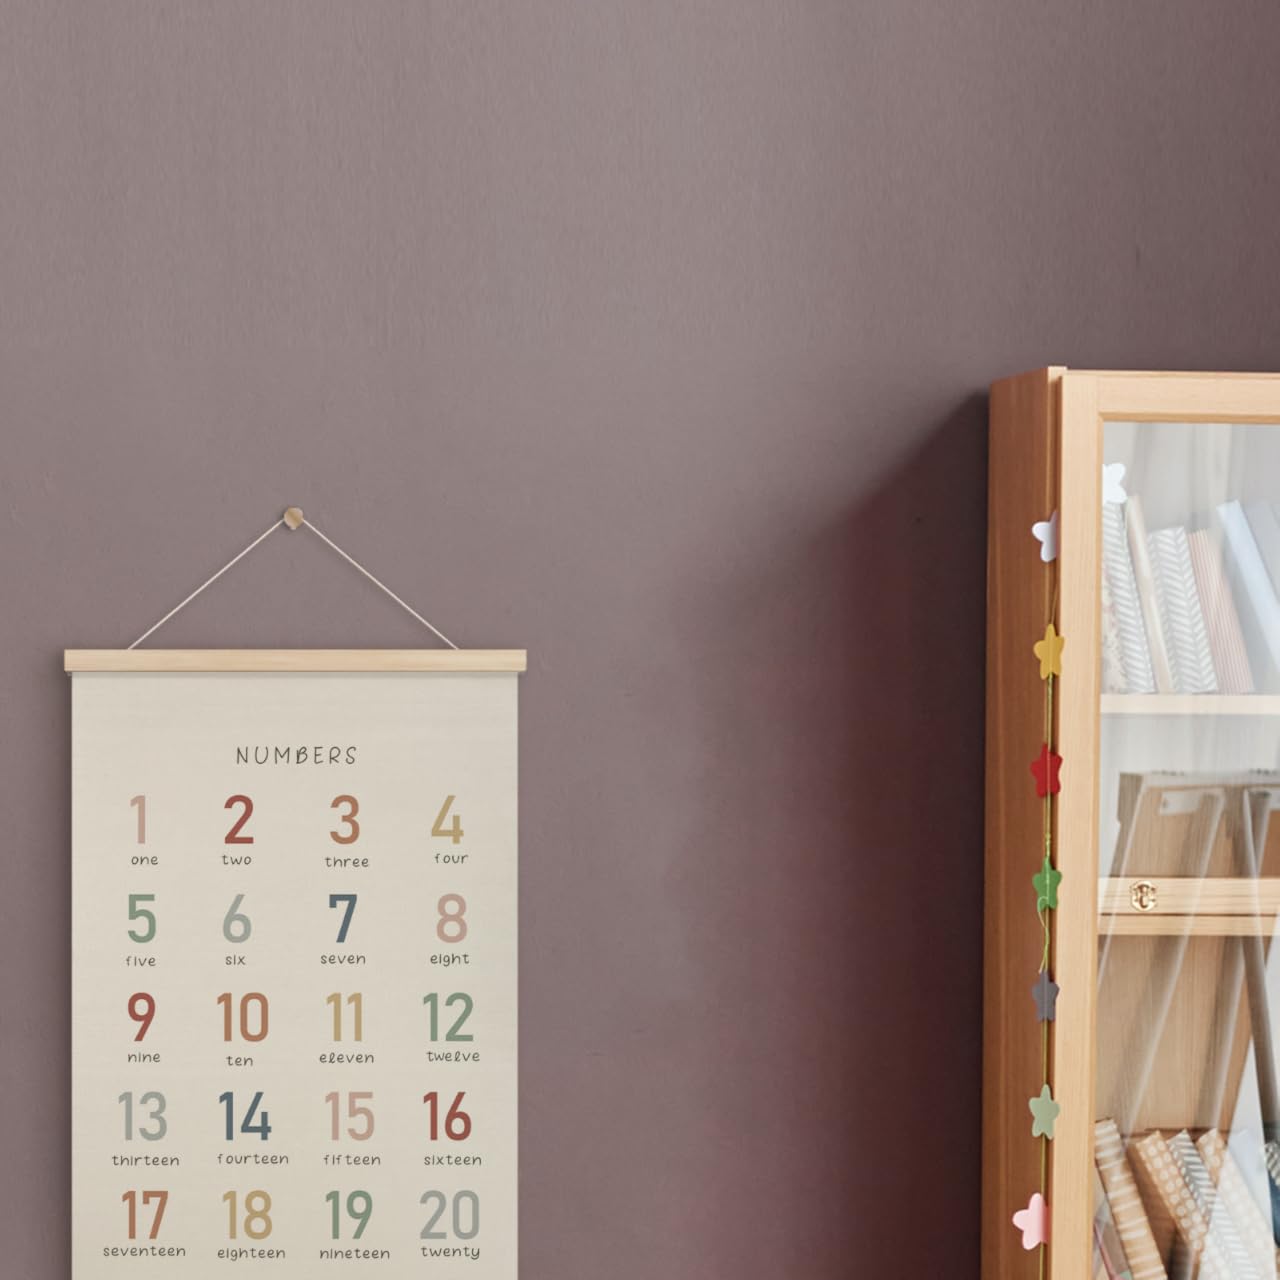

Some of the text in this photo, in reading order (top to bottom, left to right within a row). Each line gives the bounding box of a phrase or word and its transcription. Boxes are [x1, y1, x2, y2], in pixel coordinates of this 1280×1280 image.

[236, 745, 359, 767] NUMBERS
[130, 794, 146, 844] 1
[224, 793, 255, 845] 2
[329, 794, 360, 845] 3
[431, 795, 464, 845] 4
[130, 855, 160, 867] one
[220, 853, 252, 867] two
[324, 855, 370, 871] three
[434, 852, 469, 865] four
[128, 894, 156, 944] 5
[222, 894, 252, 944] 6
[328, 892, 358, 943] 7
[435, 893, 467, 944] 8
[125, 955, 156, 969] five
[225, 953, 246, 967] six
[320, 952, 366, 967] seven
[430, 951, 470, 969] eight
[128, 992, 156, 1042] 9
[217, 992, 270, 1042] 10
[326, 992, 362, 1042] 11
[422, 992, 474, 1042] 12
[128, 1051, 160, 1065] nine
[226, 1055, 253, 1068] ten
[319, 1051, 375, 1065] eleven
[426, 1048, 480, 1065] twelve
[118, 1091, 167, 1141] 13
[216, 1091, 272, 1141] 14
[325, 1091, 374, 1141] 15
[423, 1090, 472, 1141] 16
[112, 1153, 180, 1169] thirteen
[216, 1152, 289, 1167] fourteen
[323, 1153, 381, 1169] fifteen
[424, 1153, 483, 1169] sixteen
[122, 1190, 168, 1240] 17
[219, 1188, 272, 1240] 18
[325, 1190, 373, 1240] 19
[420, 1190, 480, 1240] 20
[103, 1245, 186, 1258] seventeen
[216, 1247, 285, 1263] eighteen
[320, 1247, 390, 1263] nineteen
[420, 1244, 480, 1261] twenty
